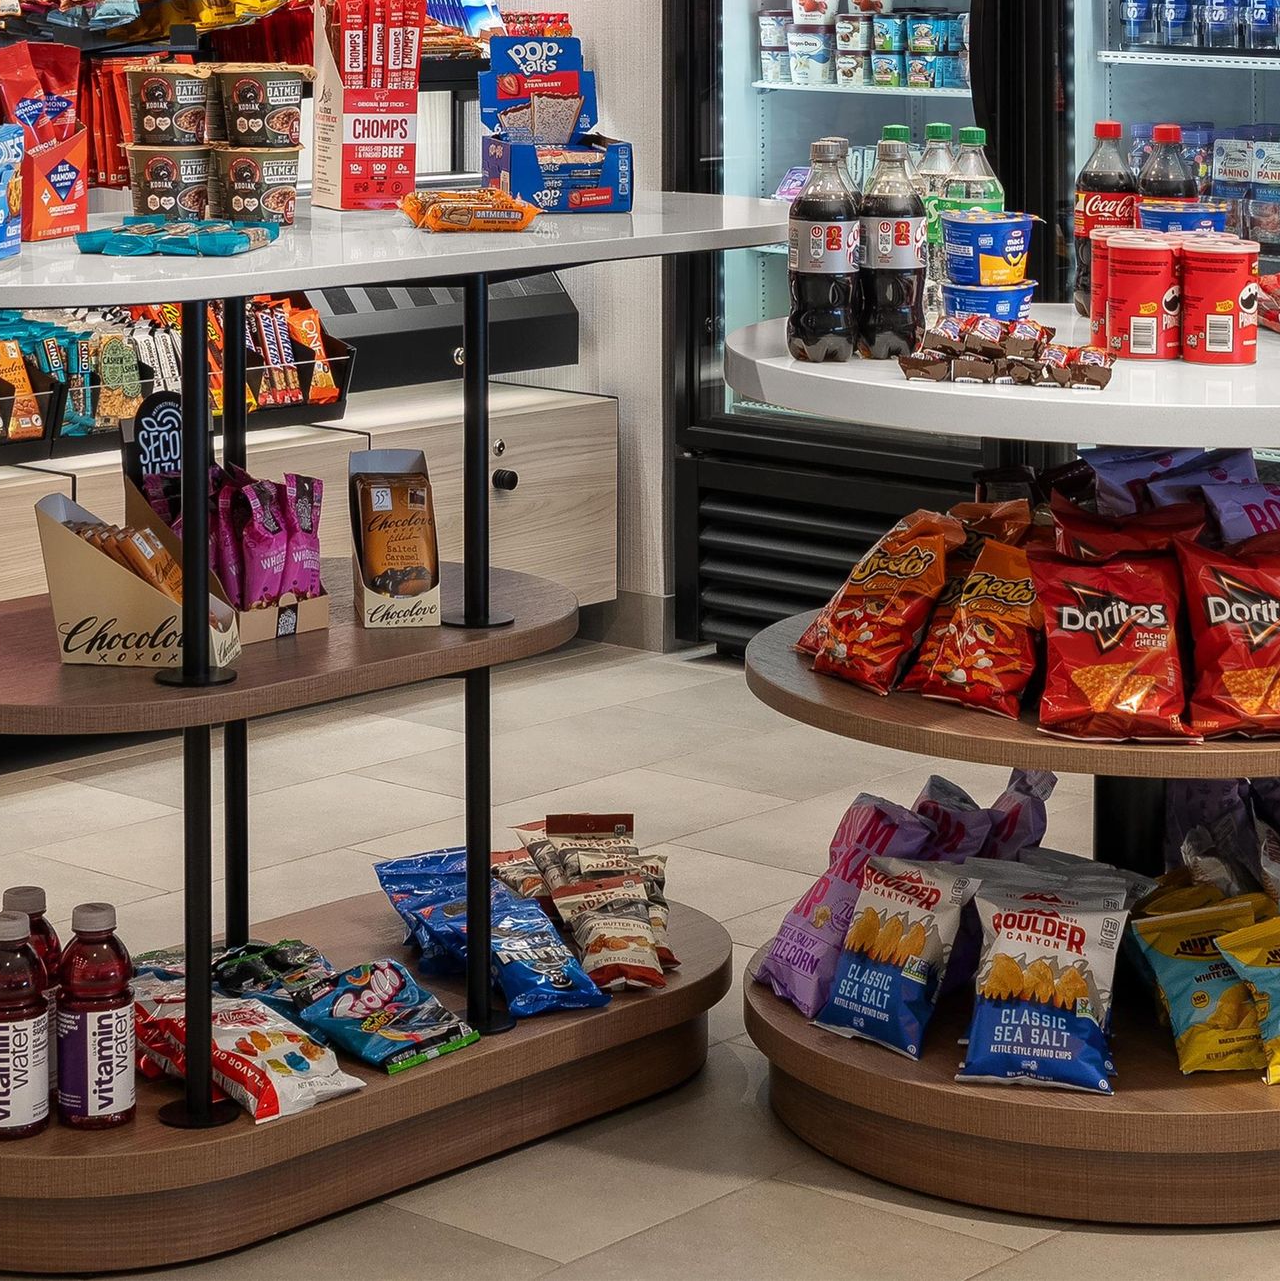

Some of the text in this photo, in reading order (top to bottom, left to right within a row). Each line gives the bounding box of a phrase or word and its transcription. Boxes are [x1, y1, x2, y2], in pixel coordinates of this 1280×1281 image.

[349, 32, 361, 70] CHOMPS
[520, 57, 557, 76] tarts
[267, 87, 301, 97] OATMEAL
[523, 80, 562, 89] STRAWBERRY
[146, 101, 169, 110] KODIAK
[352, 118, 408, 140] CHOMPS
[1217, 168, 1250, 178] PANINO
[260, 310, 281, 368] SNICKERS
[46, 338, 61, 369] KIND
[80, 341, 90, 371] KIND
[385, 553, 421, 563] Caramel
[386, 545, 418, 555] Salted
[960, 571, 1037, 607] Cheetos
[367, 601, 438, 625] Chocolove
[1061, 601, 1166, 631] Doritos
[1134, 639, 1168, 648] CHEESE
[1136, 632, 1168, 641] NACHO
[991, 911, 1087, 957] BOULDER
[1006, 931, 1060, 949] CANYON
[786, 943, 821, 976] CORN
[847, 963, 893, 992] CLASSIC
[332, 961, 406, 1019] Trolli
[838, 978, 891, 1010] SEA SALT
[1001, 1008, 1067, 1030] CLASSIC
[993, 1026, 1070, 1048] SEA SALT
[11, 1024, 29, 1090] water
[92, 1013, 114, 1111] vitamin
[989, 1044, 1072, 1060] KETTLE STYLE POTATO CHIPS
